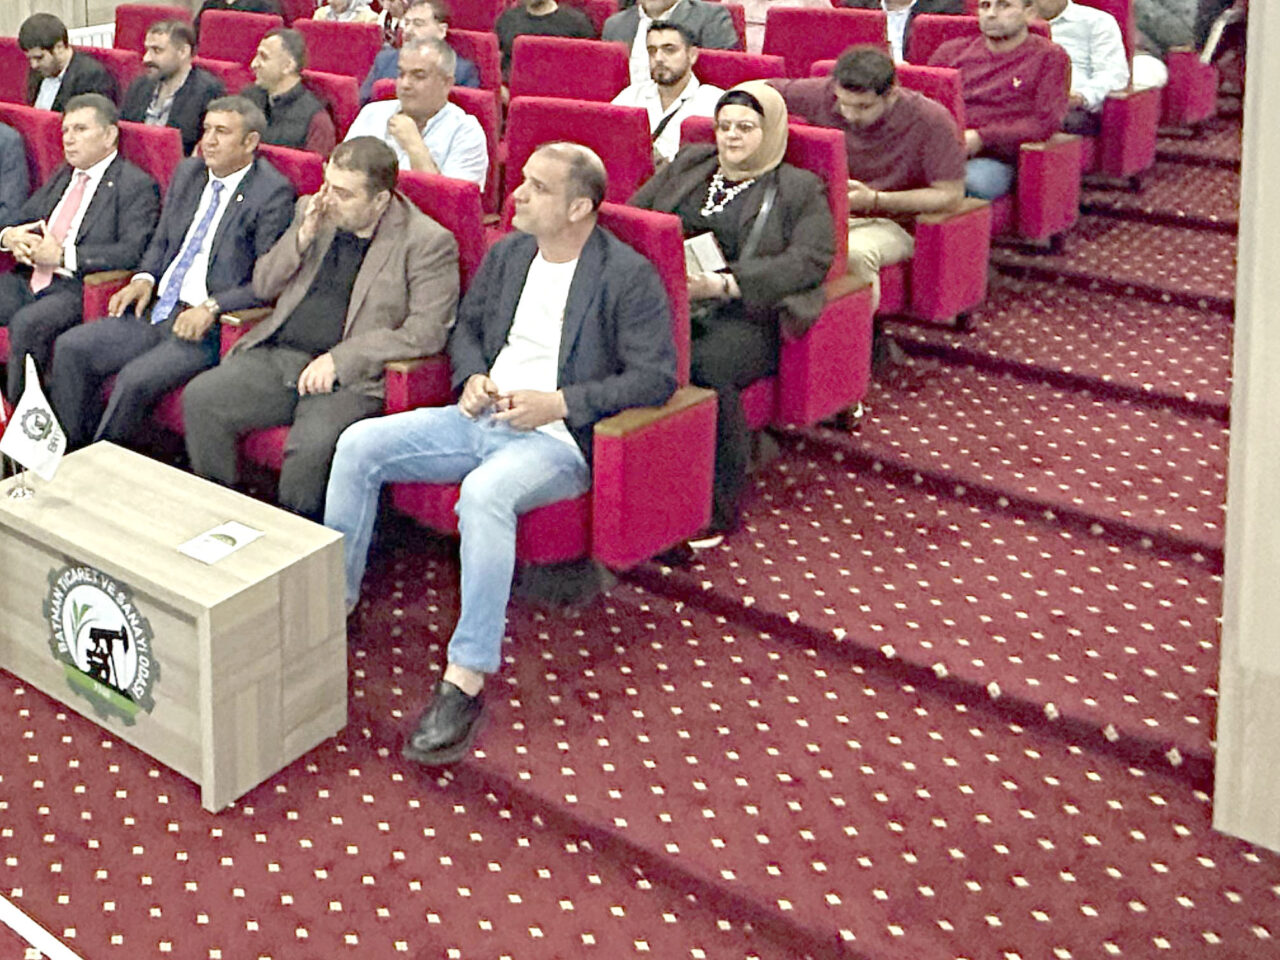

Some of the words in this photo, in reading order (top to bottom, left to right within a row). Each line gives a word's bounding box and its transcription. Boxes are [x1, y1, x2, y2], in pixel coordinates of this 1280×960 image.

[50, 586, 68, 653] BATMAN
[101, 574, 116, 597] VE
[131, 656, 150, 700] ODASI
